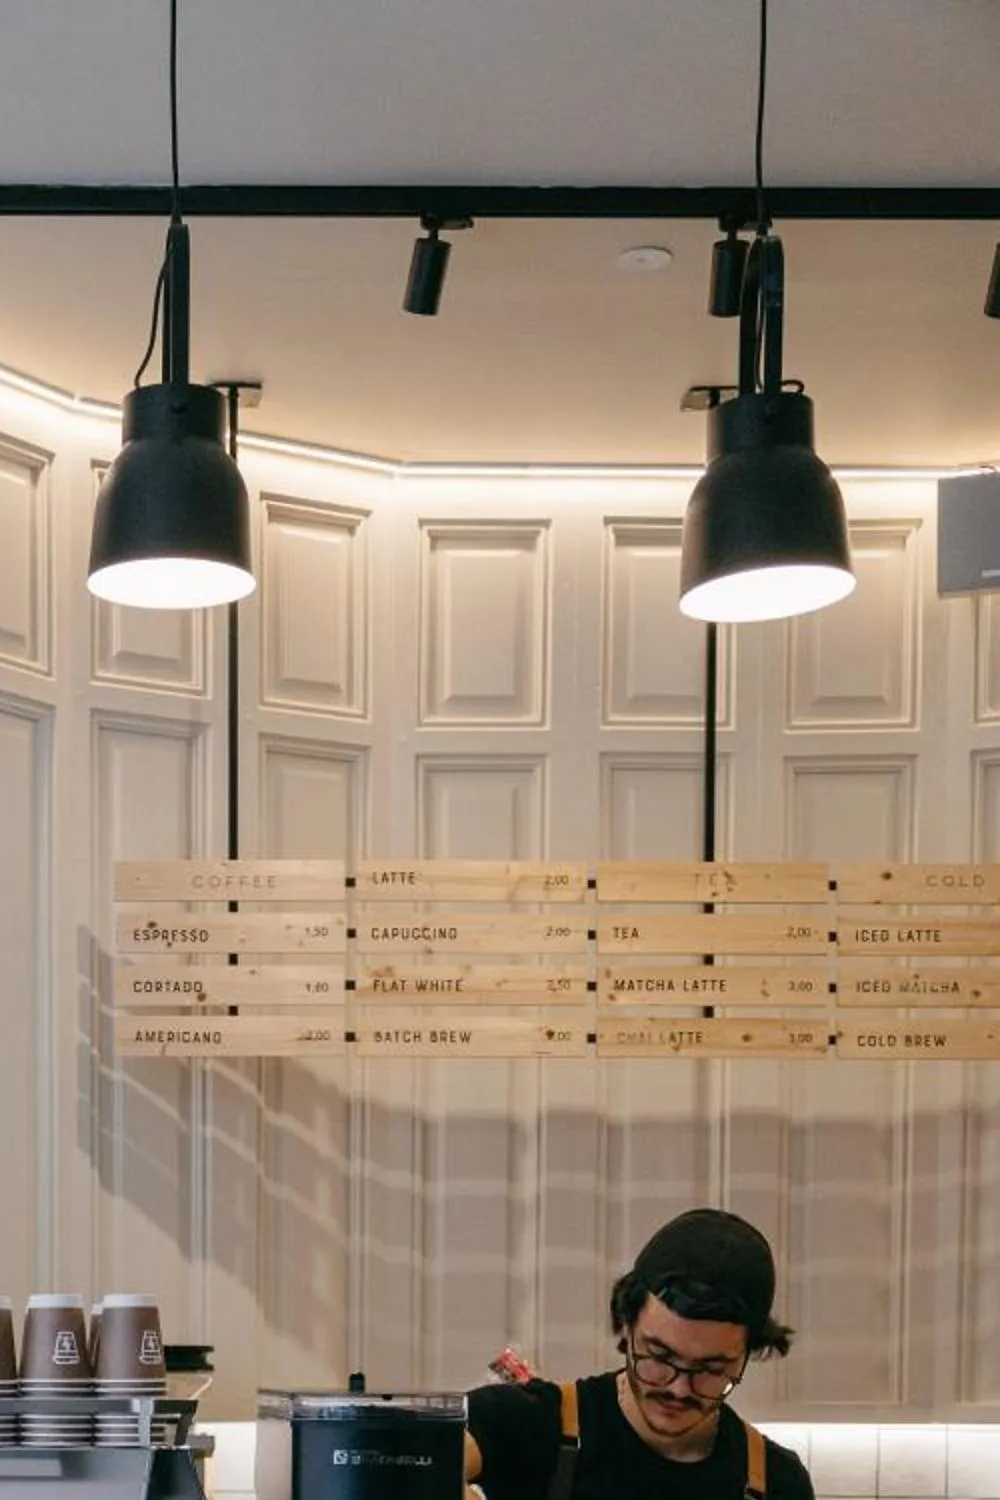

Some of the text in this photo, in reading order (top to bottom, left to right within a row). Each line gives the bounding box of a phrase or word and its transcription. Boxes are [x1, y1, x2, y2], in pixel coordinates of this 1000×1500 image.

[191, 875, 278, 889] COFFEE
[372, 872, 416, 885] LATTE
[925, 874, 985, 888] COLD
[133, 929, 209, 943] ESPRESSO
[371, 927, 458, 940] CAPUCCINO
[612, 927, 639, 939] TEA
[855, 929, 942, 942] ICED LATTE
[132, 981, 203, 993] CORTADO
[373, 979, 407, 992] FLAT
[415, 979, 465, 992] WHITE
[613, 979, 675, 992] MATCHA
[683, 979, 728, 992] LATTE
[856, 980, 960, 993] ICED MATCHA
[135, 1031, 222, 1044] AMERICANO
[374, 1031, 422, 1043] BATCH
[430, 1031, 472, 1043] BREW
[659, 1031, 703, 1044] LATTE
[857, 1034, 947, 1047] COLD BREW
